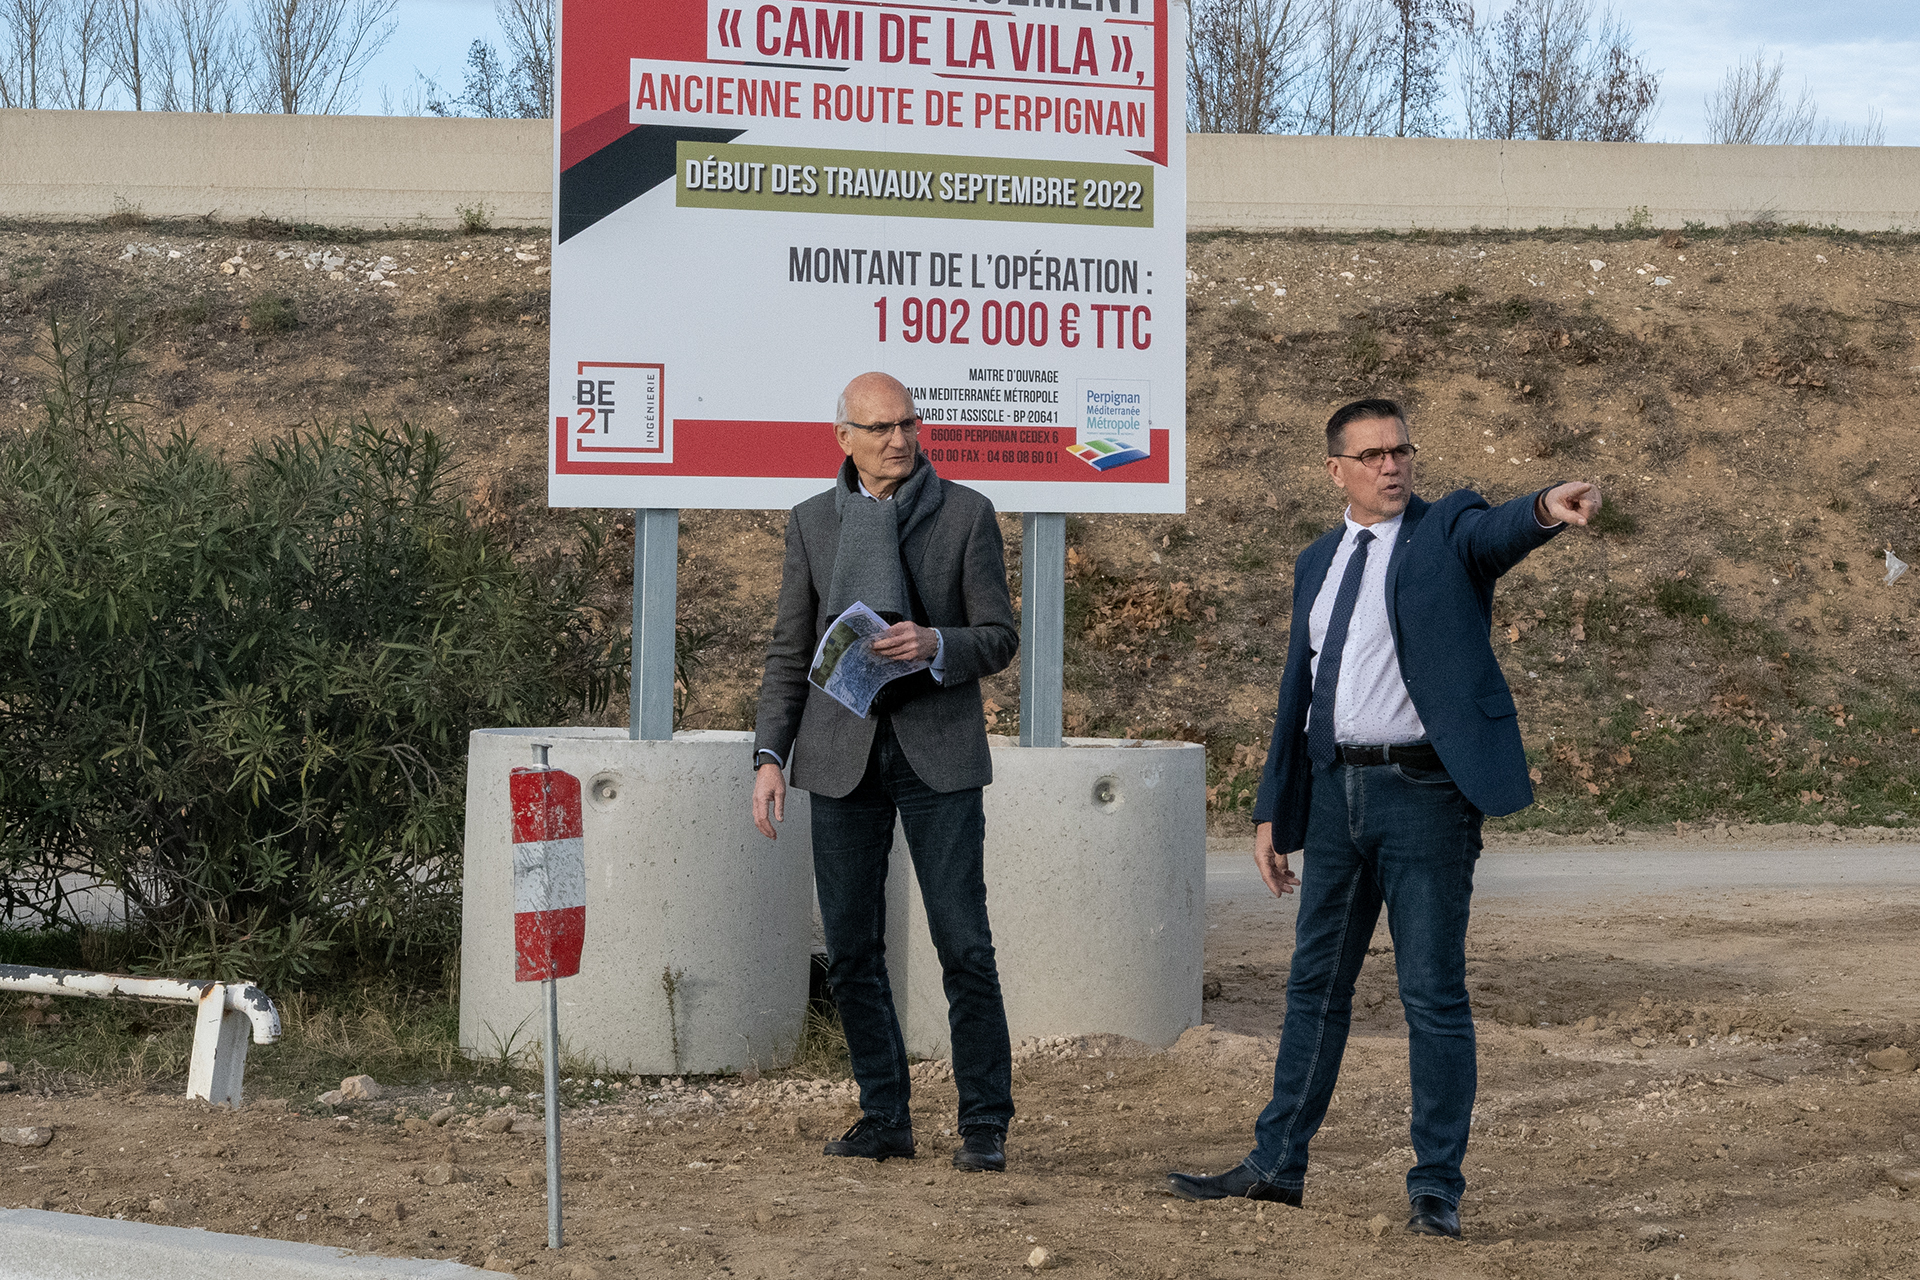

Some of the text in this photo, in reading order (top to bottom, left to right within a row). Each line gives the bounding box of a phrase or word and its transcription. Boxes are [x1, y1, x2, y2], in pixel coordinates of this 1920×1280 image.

[756, 4, 863, 61] CAMI
[879, 13, 931, 65] DE
[946, 18, 995, 69] LA
[1008, 22, 1099, 76] VILA
[636, 72, 1145, 137] ANCIENNE ROUTE DE PERPIGNAN
[685, 155, 1142, 210] DÉBUT DES TRAVAUX SEPTEMBRE 2022
[789, 246, 921, 286] MONTANT
[930, 252, 962, 287] DE
[874, 296, 1152, 350] 1 902 000 € TTC
[969, 368, 1059, 383] MAITRE D'OUVRAGE
[577, 379, 615, 406] BE
[929, 387, 1001, 402] MEDITERRANÉE
[1004, 387, 1059, 403] MÉTROPOLE
[1086, 390, 1140, 406] Perpignan
[644, 374, 655, 443] INGÉNIERIE
[946, 408, 958, 421] ST
[960, 408, 1004, 422] ASSISCLE
[1013, 410, 1026, 422] BP
[1028, 410, 1058, 423] 20641
[1086, 405, 1140, 416] Méditerranée
[577, 408, 615, 434] 2T
[1086, 416, 1140, 435] Métropole
[931, 428, 1059, 444] 66006 PERPIGNAN CEDEX 6
[931, 448, 944, 462] 60
[961, 449, 980, 463] FAX
[987, 449, 1000, 463] 04
